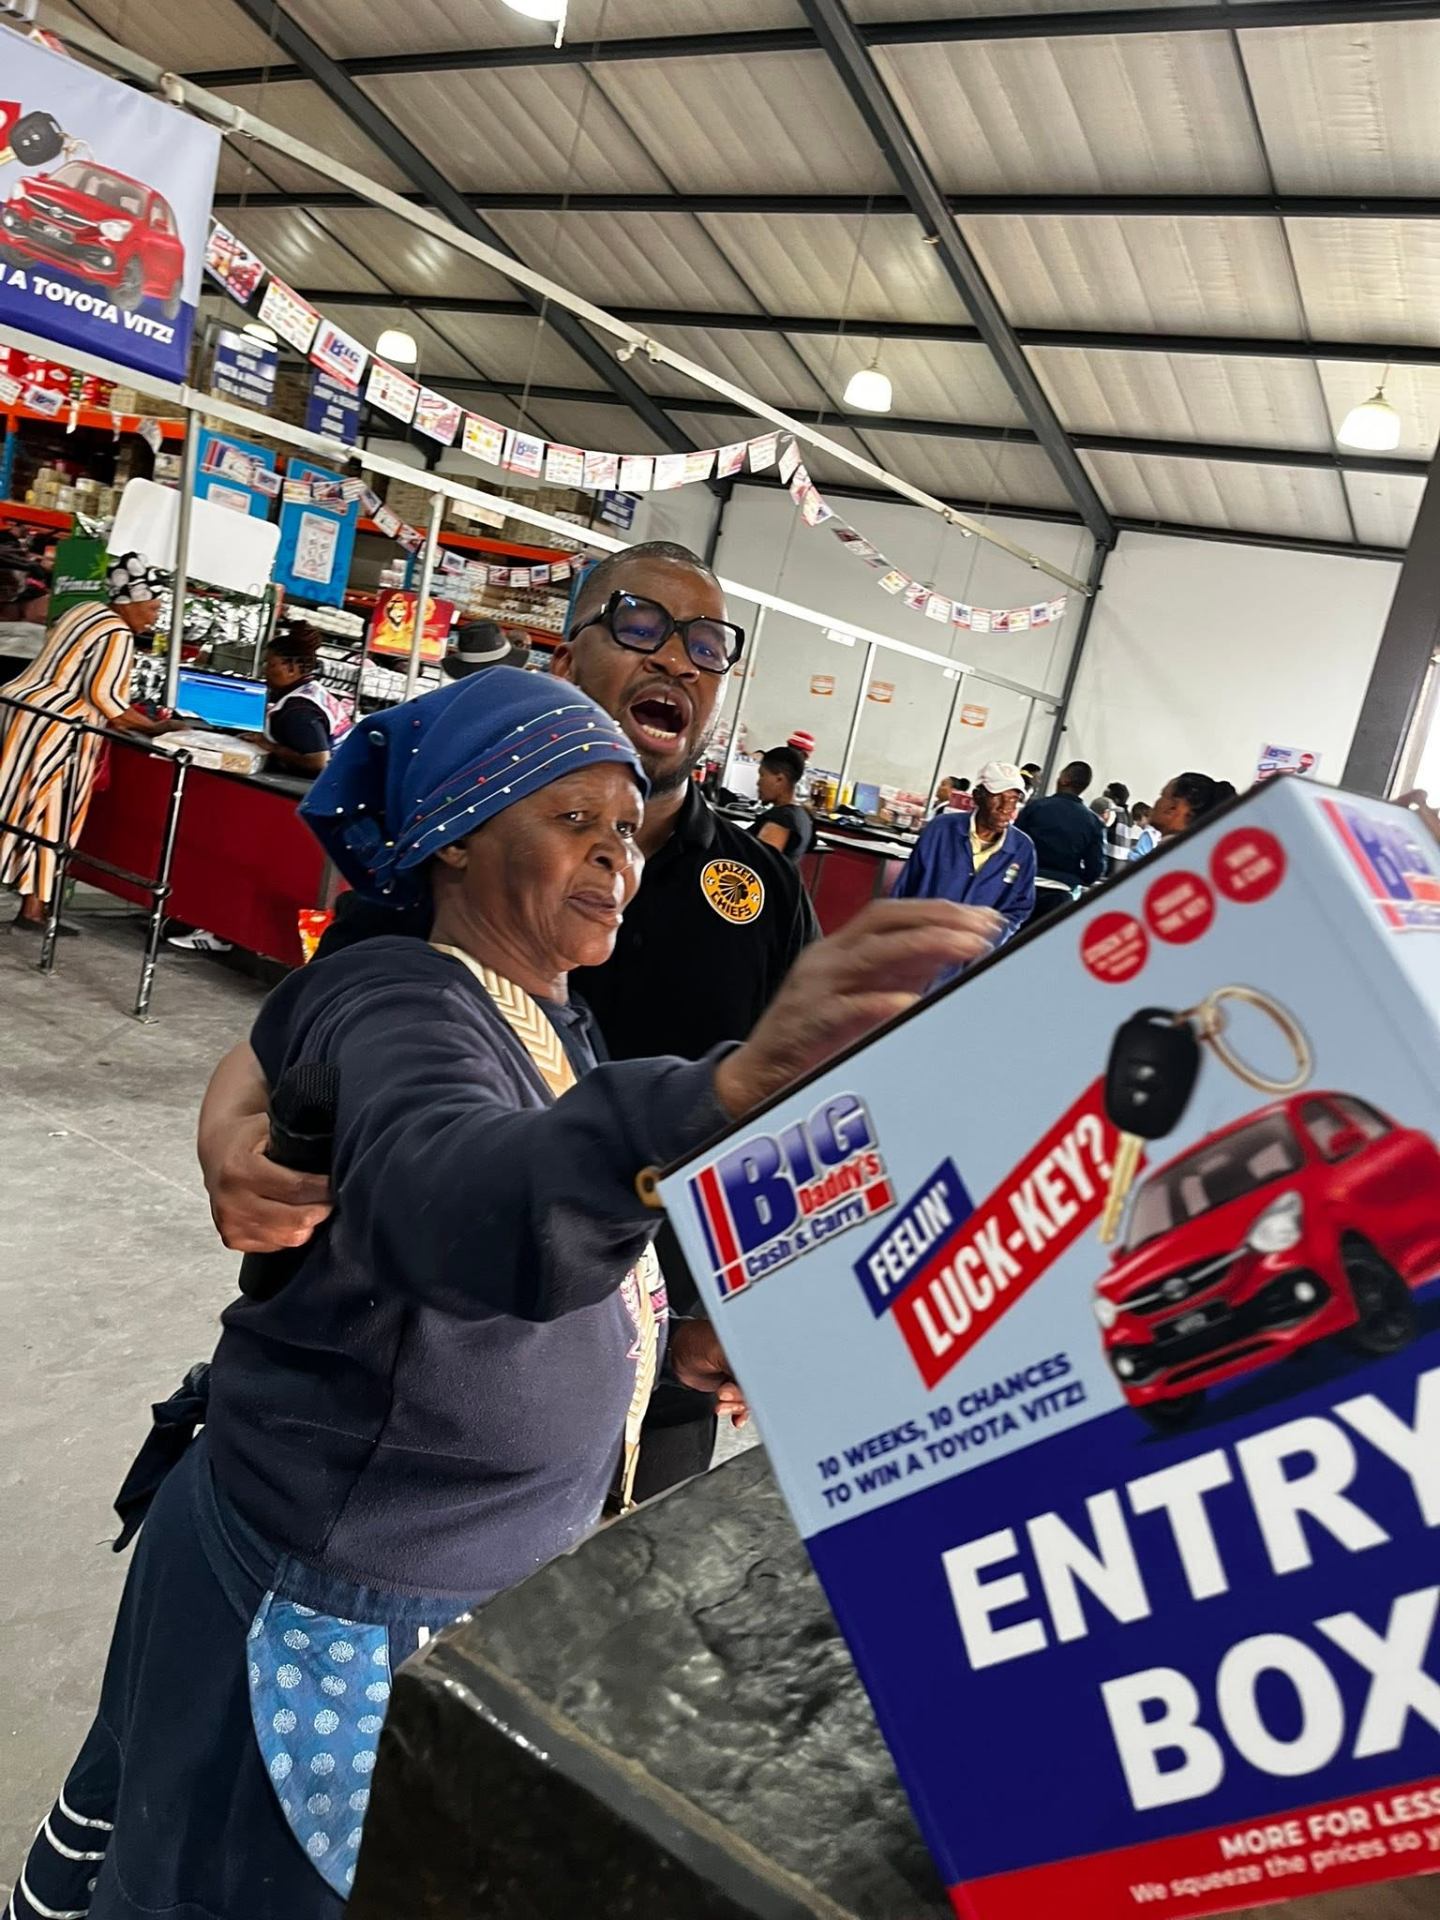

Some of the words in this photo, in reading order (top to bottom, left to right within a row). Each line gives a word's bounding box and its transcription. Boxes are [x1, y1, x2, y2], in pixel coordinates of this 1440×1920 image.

[7, 270, 28, 290] A
[32, 276, 119, 324] TOYOTA
[123, 310, 175, 345] VITZ!
[711, 891, 753, 918] CHIEFS
[713, 863, 757, 886] KAIZER
[717, 1092, 873, 1256] BIG
[798, 1151, 881, 1217] Daddy's
[744, 1239, 791, 1277] Cash
[794, 1230, 809, 1251] &
[810, 1199, 865, 1241] Carry
[867, 1181, 951, 1297] FEELIN'
[911, 1113, 1114, 1358] LUCK-KEY?
[817, 1455, 841, 1480] 10
[842, 1420, 928, 1468] WEEKS,
[927, 1405, 953, 1431] 10
[956, 1351, 1072, 1418] CHANCES
[821, 1482, 852, 1509] TO
[853, 1460, 902, 1495] WIN
[906, 1452, 925, 1475] A
[924, 1411, 1021, 1465] TOYOTA
[1019, 1379, 1088, 1423] VITZ!
[941, 1365, 1440, 1671] ENTRY
[1100, 1584, 1440, 1812] BOX
[1128, 1881, 1169, 1904] We
[1169, 1863, 1263, 1898] squeeze
[1264, 1854, 1307, 1878] the
[1311, 1837, 1387, 1874] prices
[1389, 1830, 1422, 1852] so
[1218, 1820, 1306, 1861] MORE
[1306, 1805, 1372, 1841] FOR
